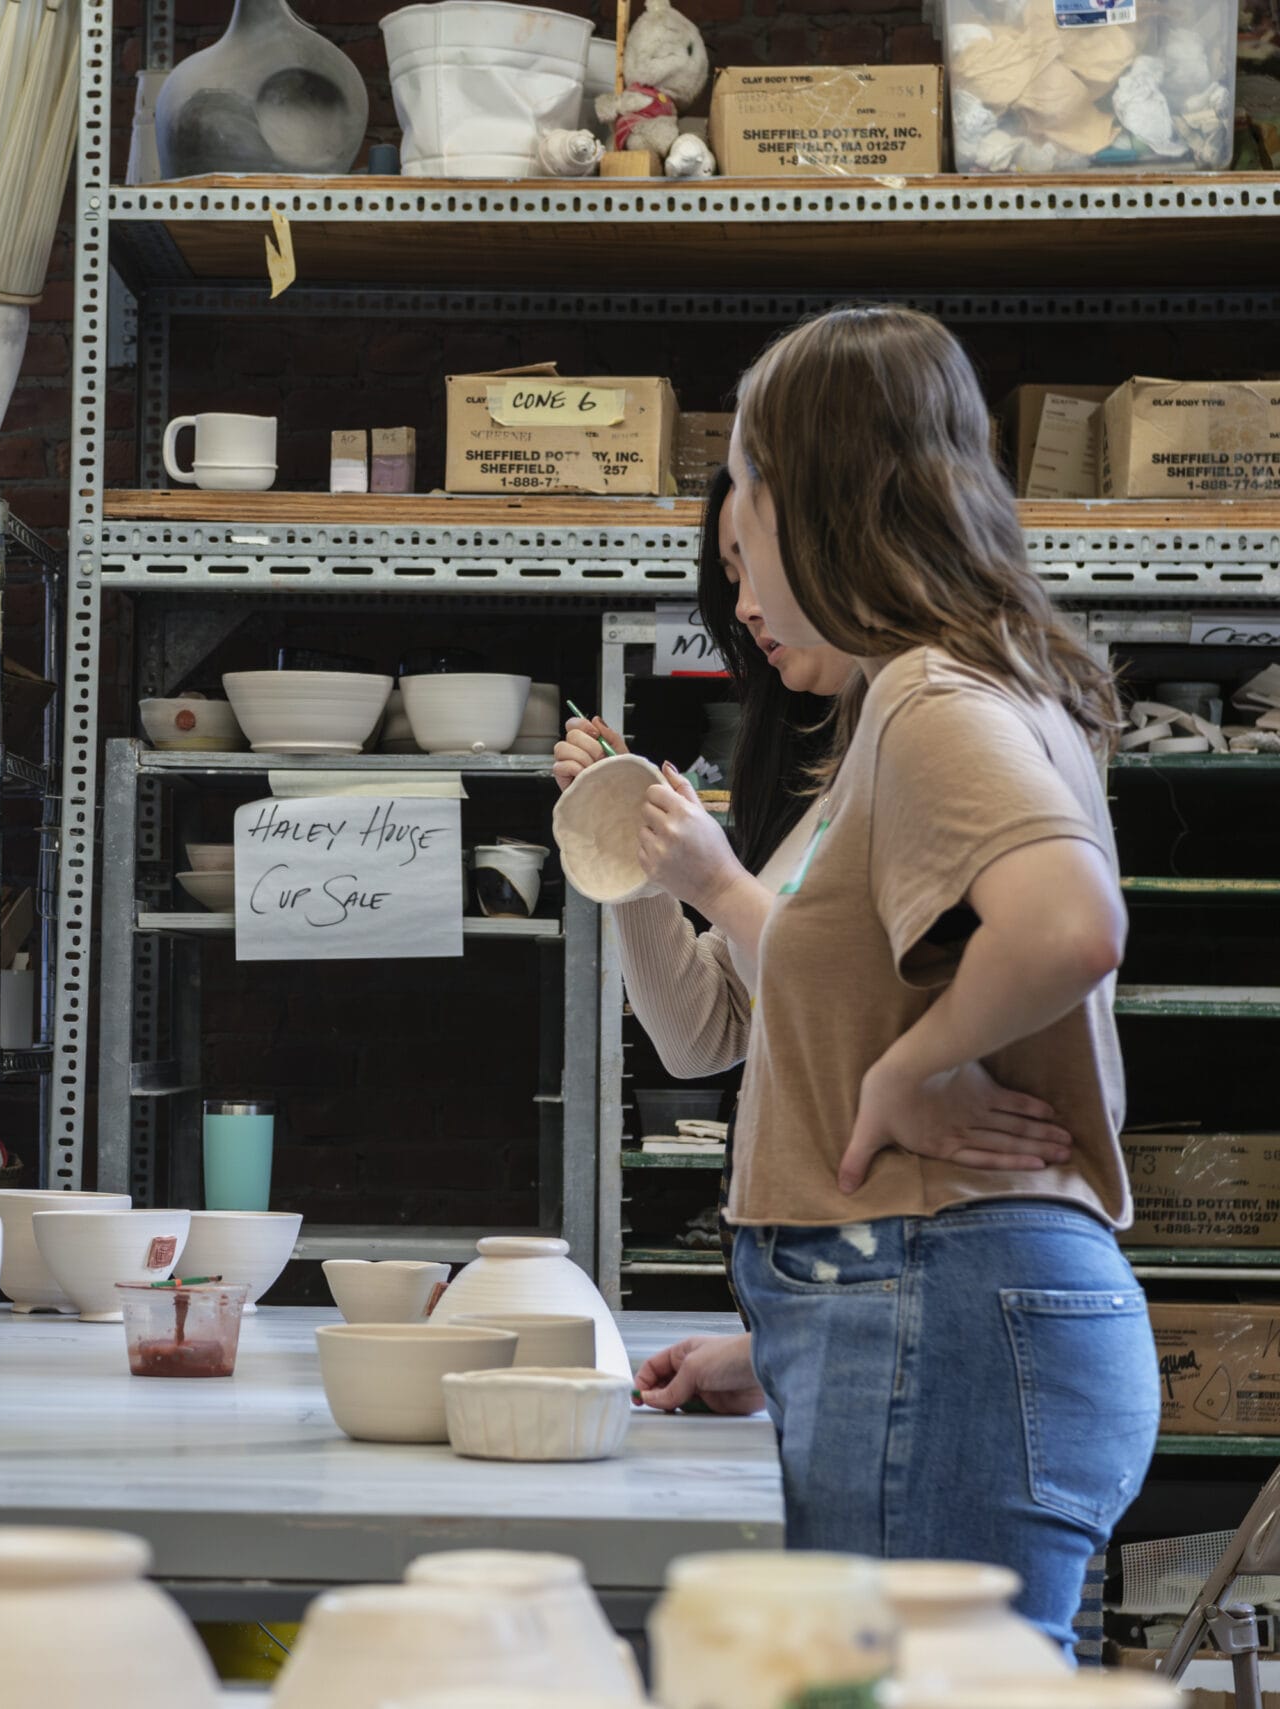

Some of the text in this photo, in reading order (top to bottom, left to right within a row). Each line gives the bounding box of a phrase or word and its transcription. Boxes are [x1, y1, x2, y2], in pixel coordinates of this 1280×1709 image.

[742, 76, 762, 84] CLAY
[764, 75, 788, 84] BODY
[742, 127, 922, 141] SHEFFIELD POTTERY, INC.
[841, 141, 862, 152] MA
[866, 140, 907, 152] 01257
[465, 396, 486, 404] CLAY
[512, 389, 597, 411] CONE 6
[1152, 399, 1174, 407] CLAY
[1175, 399, 1200, 407] BODY
[465, 450, 540, 461] SHEFFIELD
[615, 451, 644, 463] INC.
[1152, 453, 1229, 464] SHEFFIELD
[480, 463, 560, 475] SHEFFIELD,
[1167, 466, 1274, 478] SHEFFIELD, MA
[248, 801, 451, 867] HALEY HOUSE
[250, 863, 393, 927] CUP SALE
[1135, 1200, 1192, 1209] EFFIELD
[1197, 1200, 1262, 1210] POTTERY,
[1215, 1211, 1236, 1221] MA
[1240, 1212, 1278, 1222] 01257
